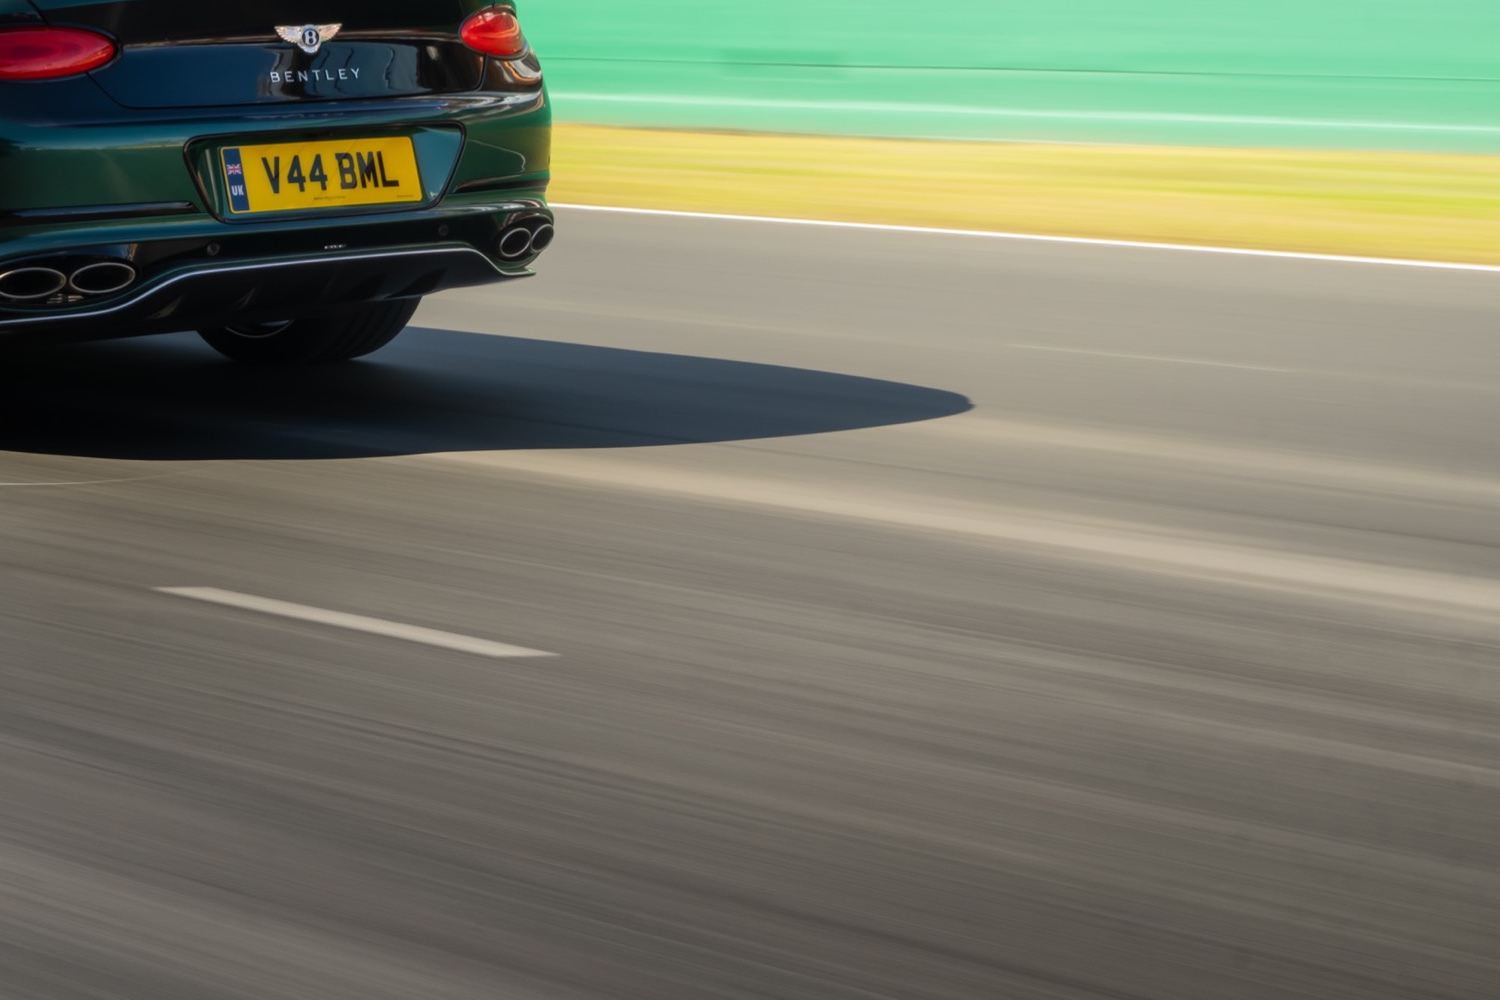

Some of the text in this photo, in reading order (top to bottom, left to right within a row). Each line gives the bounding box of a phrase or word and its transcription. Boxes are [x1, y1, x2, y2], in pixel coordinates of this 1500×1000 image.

[304, 30, 318, 46] B
[269, 67, 360, 83] BENTLEY
[261, 150, 400, 194] V44 BML
[231, 184, 245, 197] UK
